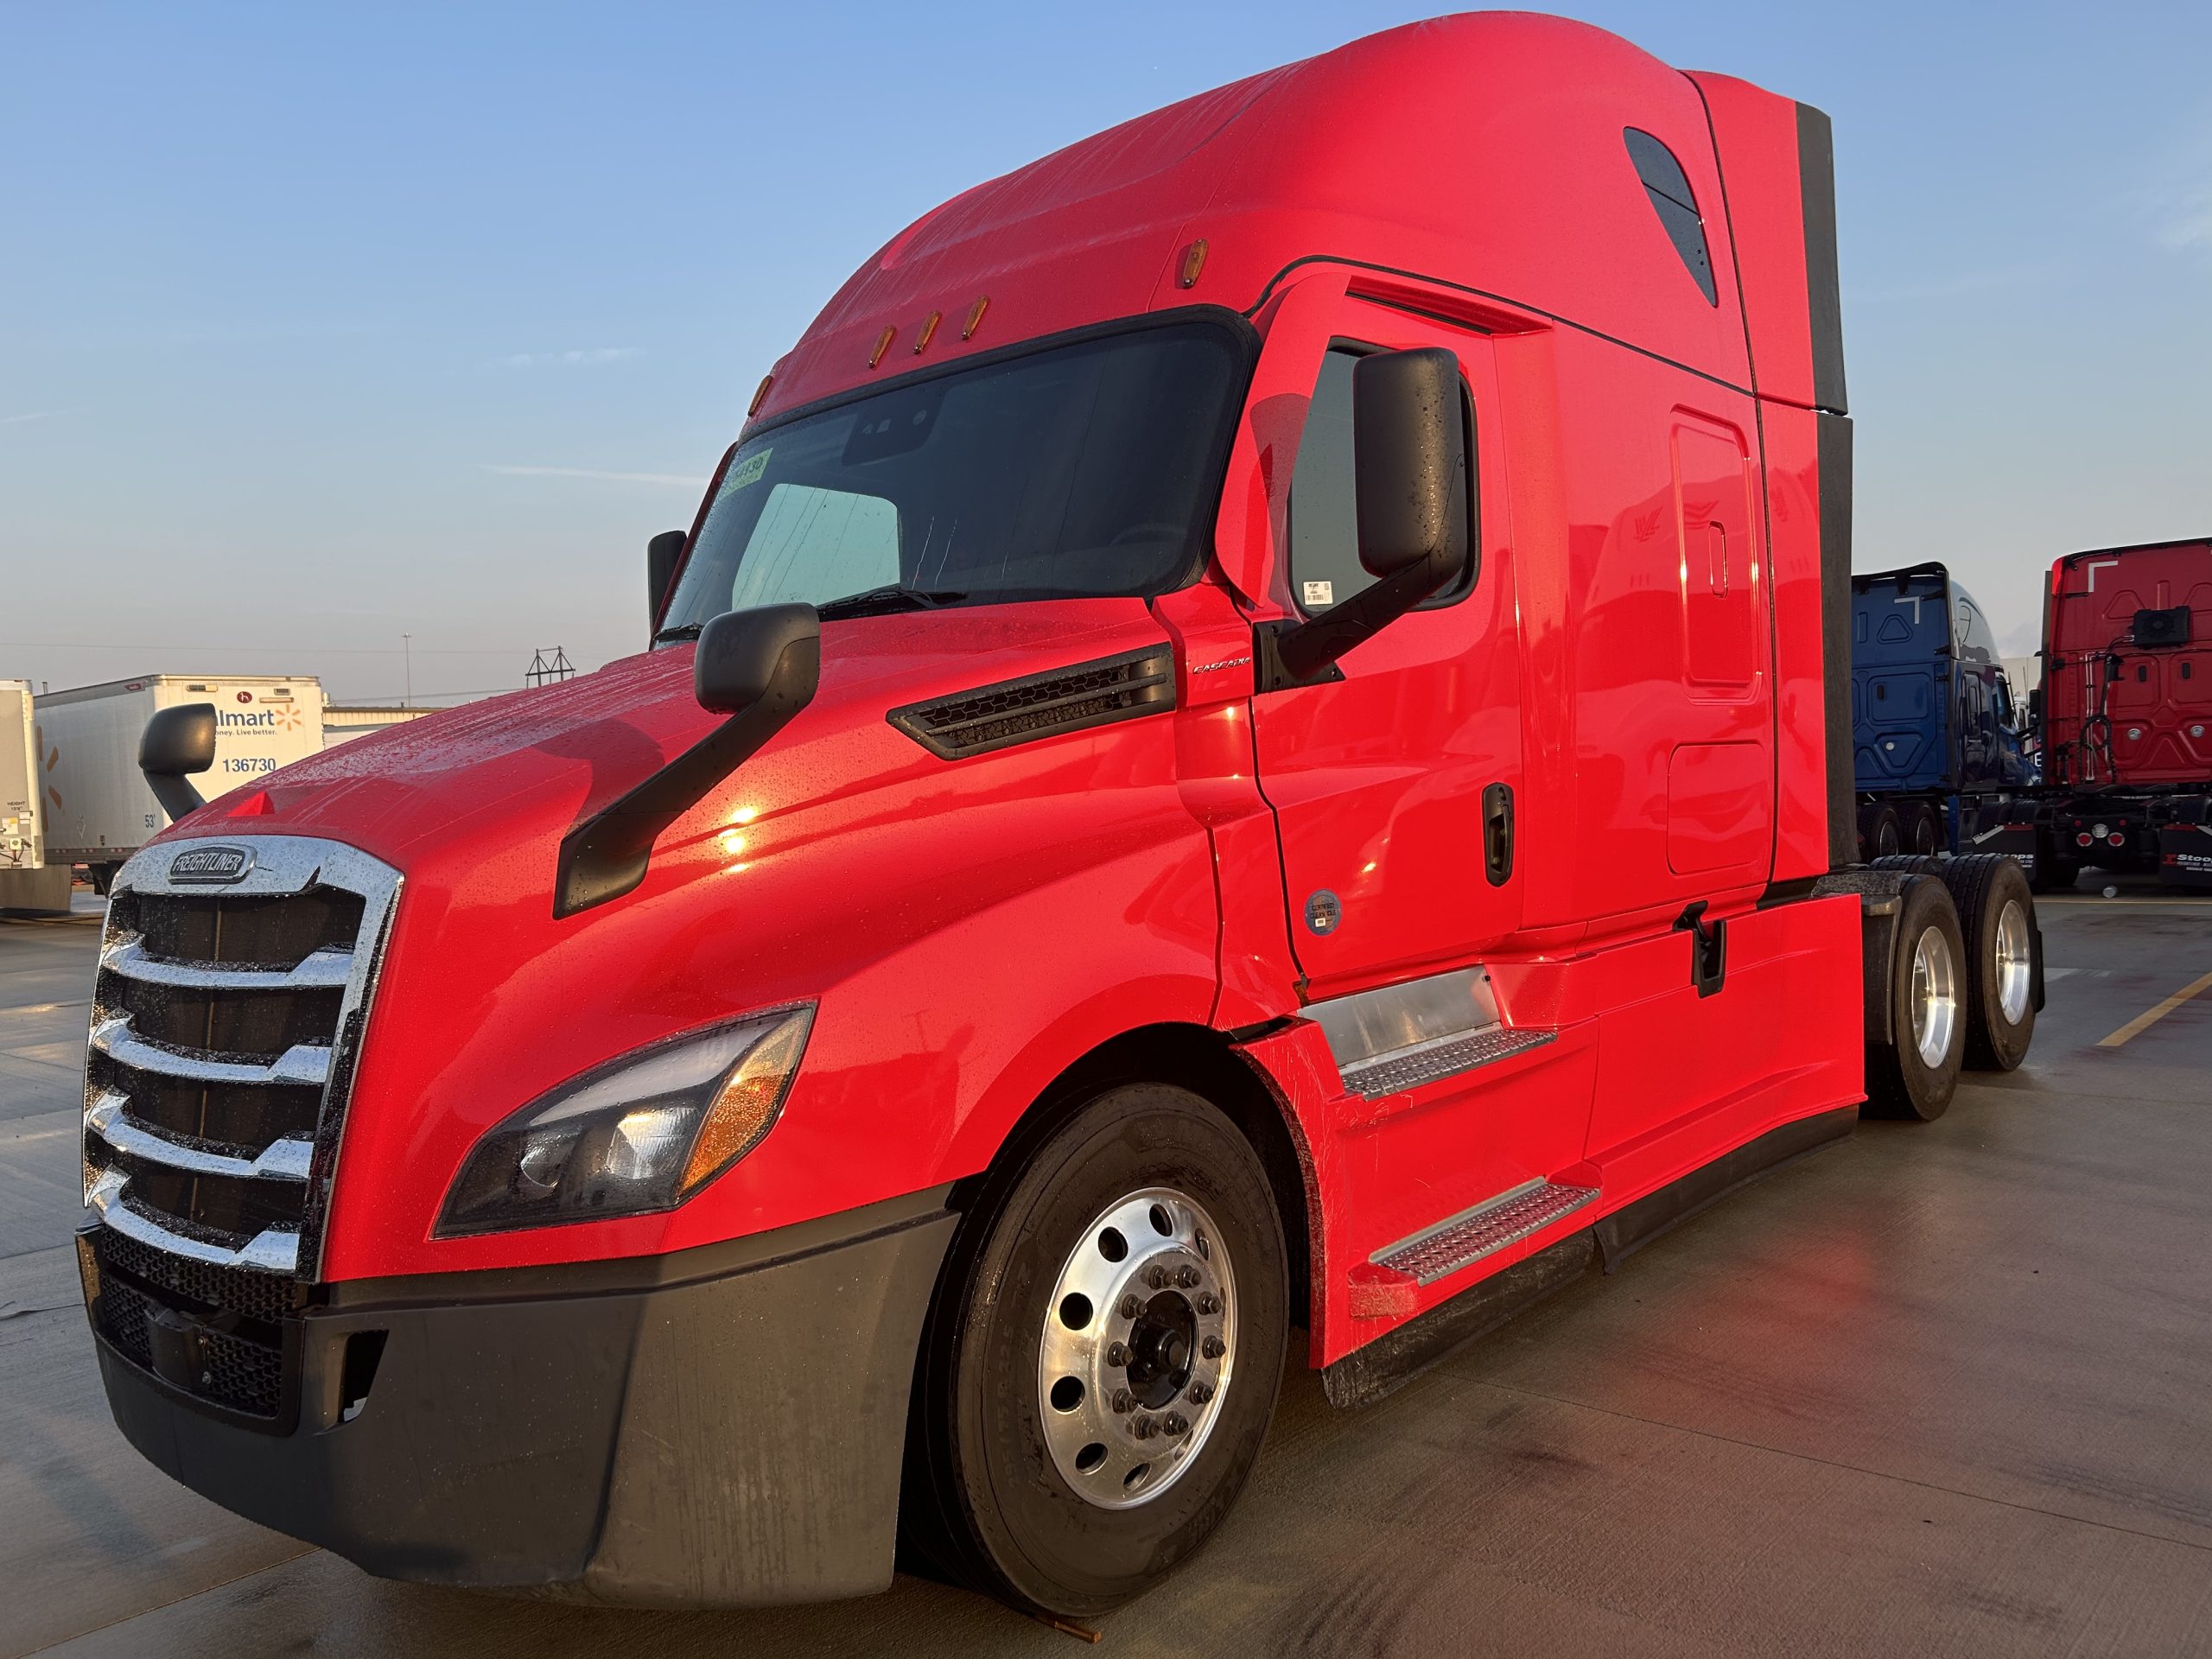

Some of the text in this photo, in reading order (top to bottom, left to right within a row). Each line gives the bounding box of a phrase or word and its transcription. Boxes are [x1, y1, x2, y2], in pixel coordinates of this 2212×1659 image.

[1193, 658, 1250, 674] CASCADIA
[216, 709, 275, 727] lmart
[223, 759, 276, 772] 136730
[173, 853, 243, 872] FREIGHTLINER
[2177, 854, 2212, 862] Stoo
